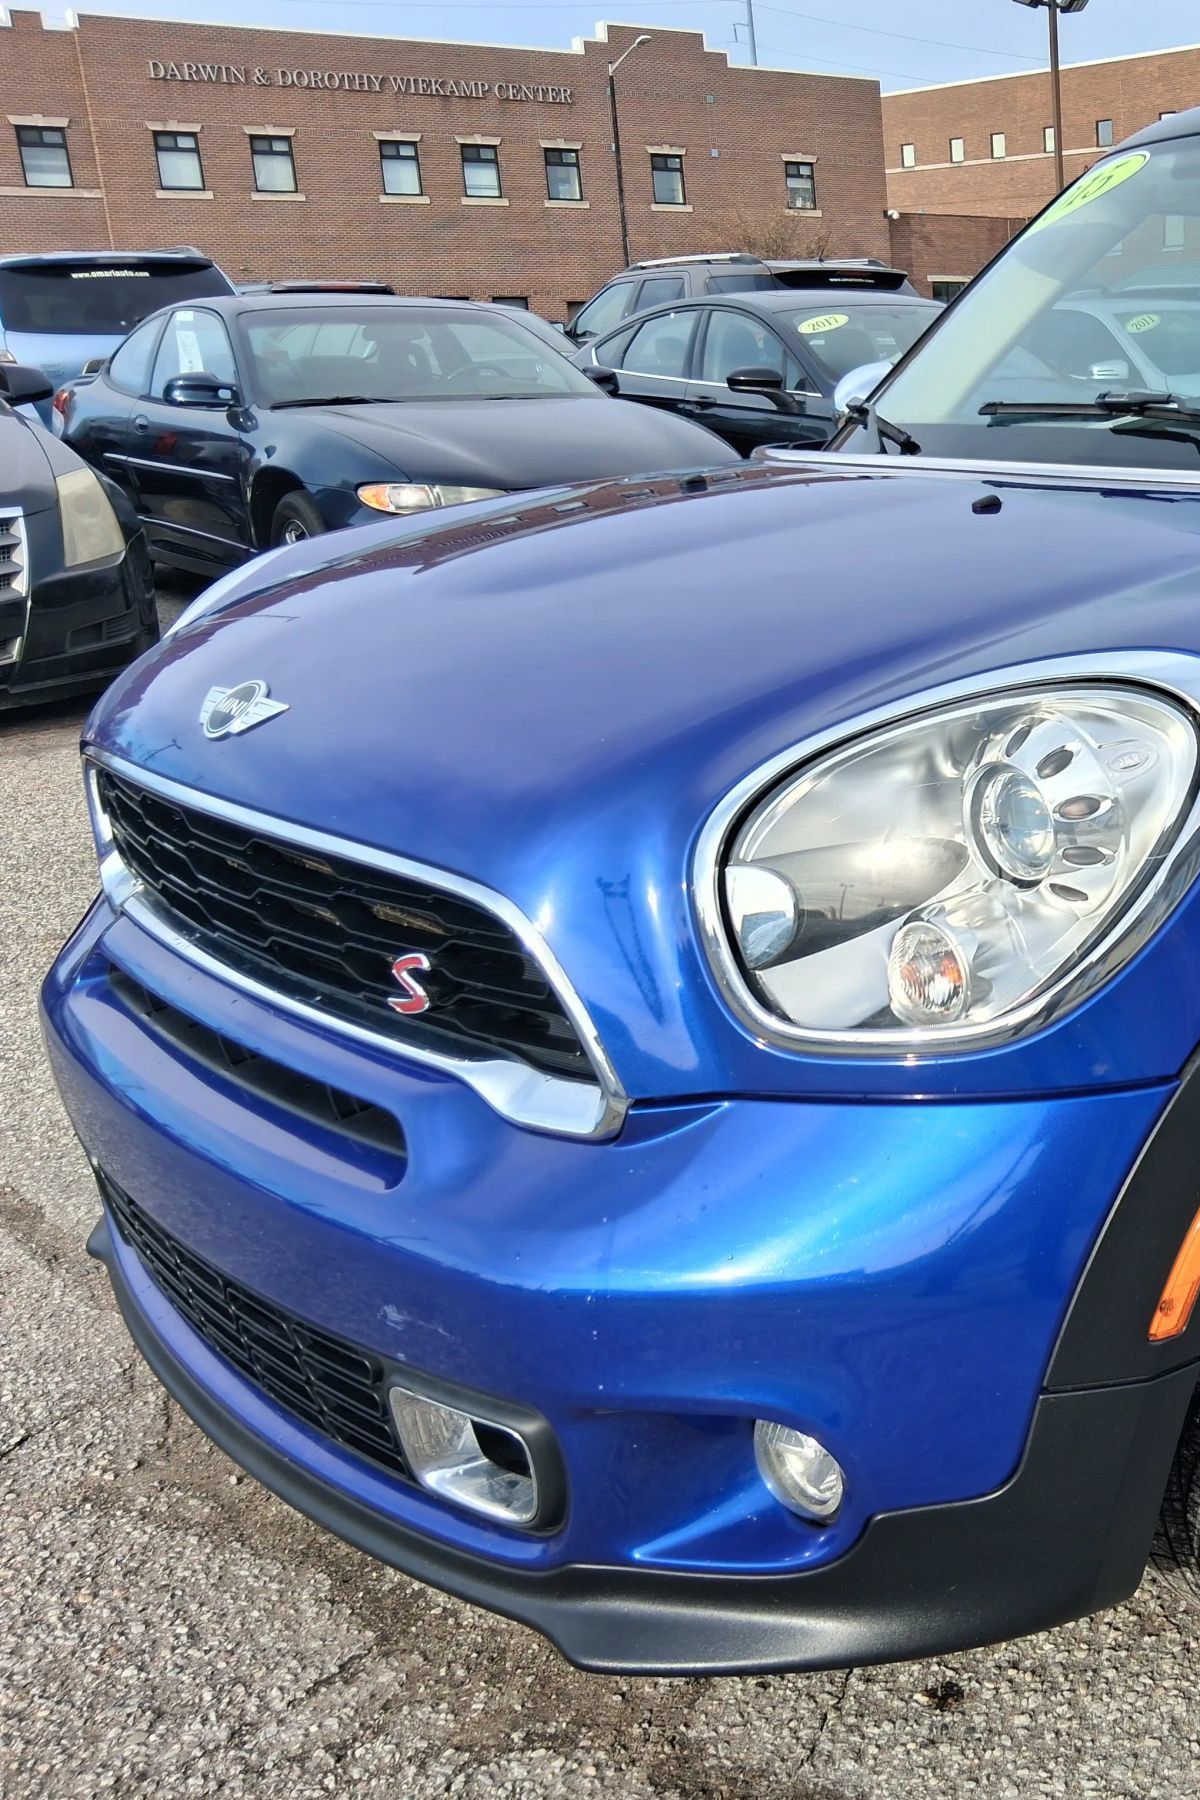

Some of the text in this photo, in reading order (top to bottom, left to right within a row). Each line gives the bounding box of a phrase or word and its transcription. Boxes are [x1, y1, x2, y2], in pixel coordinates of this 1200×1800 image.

[148, 60, 574, 104] DARWIN & DOROTHY WIEKAMP CENTER
[807, 315, 839, 332] 2017
[1131, 315, 1156, 331] 2011
[214, 696, 250, 717] MINI
[386, 952, 432, 1015] S
